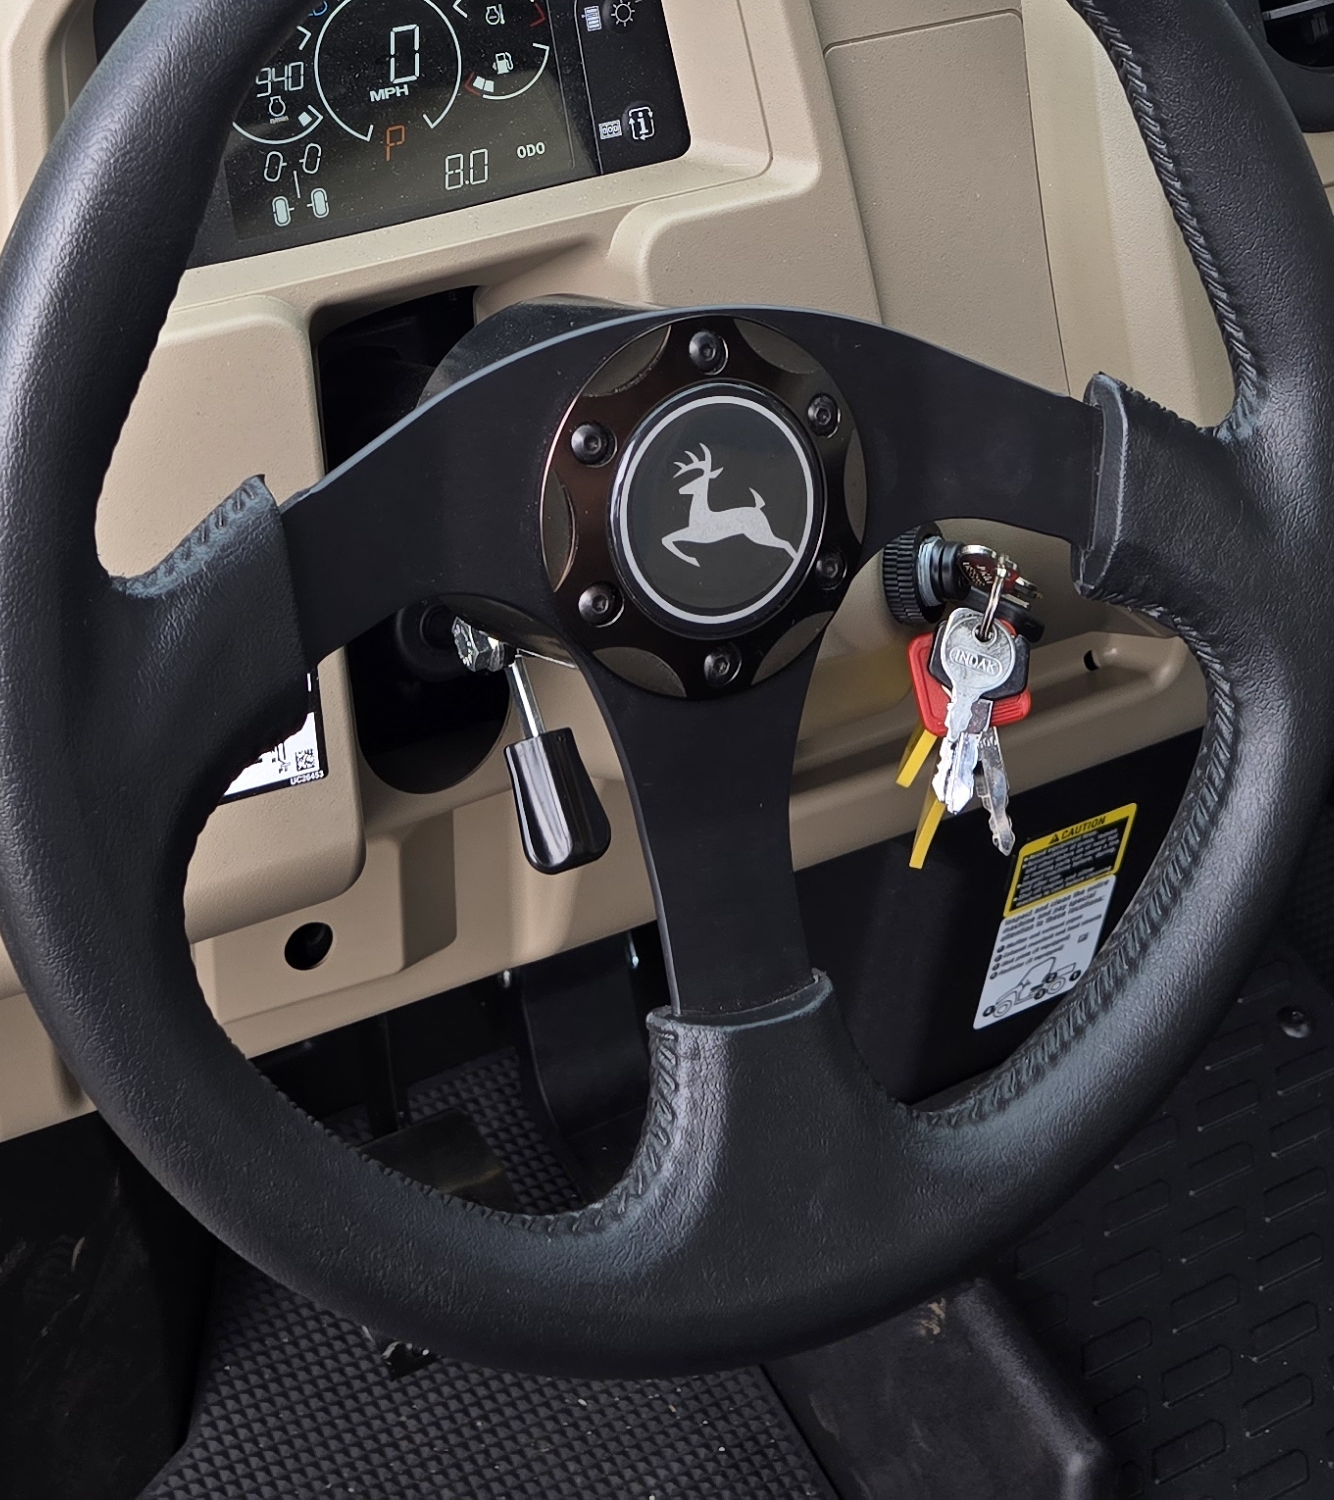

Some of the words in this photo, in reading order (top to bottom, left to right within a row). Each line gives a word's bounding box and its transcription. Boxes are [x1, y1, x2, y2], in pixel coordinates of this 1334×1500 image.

[389, 23, 420, 85] 0
[256, 62, 304, 98] 940
[369, 83, 409, 103] MPH
[385, 124, 406, 161] P
[445, 149, 489, 191] 8.0
[516, 141, 546, 159] ODO
[954, 648, 998, 676] INDAK
[1061, 816, 1106, 840] CAUTION
